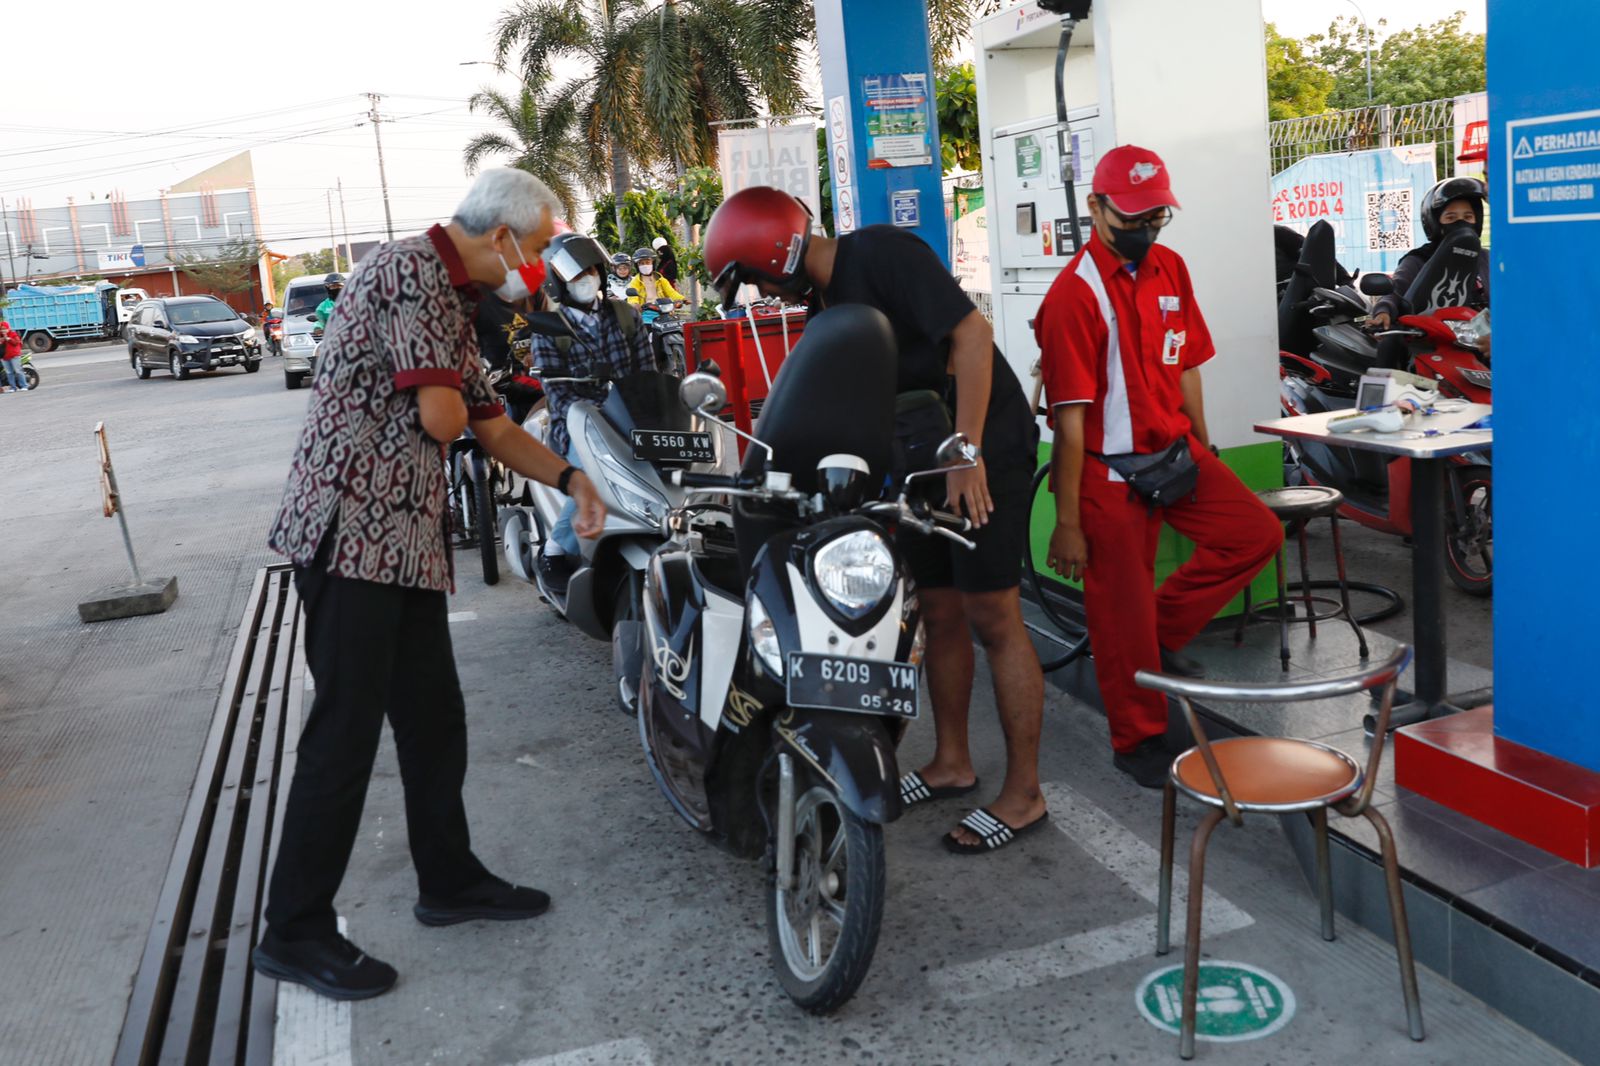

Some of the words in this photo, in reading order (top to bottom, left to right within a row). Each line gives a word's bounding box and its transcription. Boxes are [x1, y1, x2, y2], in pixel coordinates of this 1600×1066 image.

[1293, 181, 1344, 201] SUBSIDI
[1288, 199, 1330, 219] RODA
[1334, 198, 1344, 215] 4
[107, 253, 129, 262] TIKI
[634, 434, 643, 446] K
[652, 435, 685, 447] 5560
[692, 437, 709, 448] KW
[791, 656, 804, 678] K
[821, 659, 870, 684] 6209
[888, 666, 915, 691] YM
